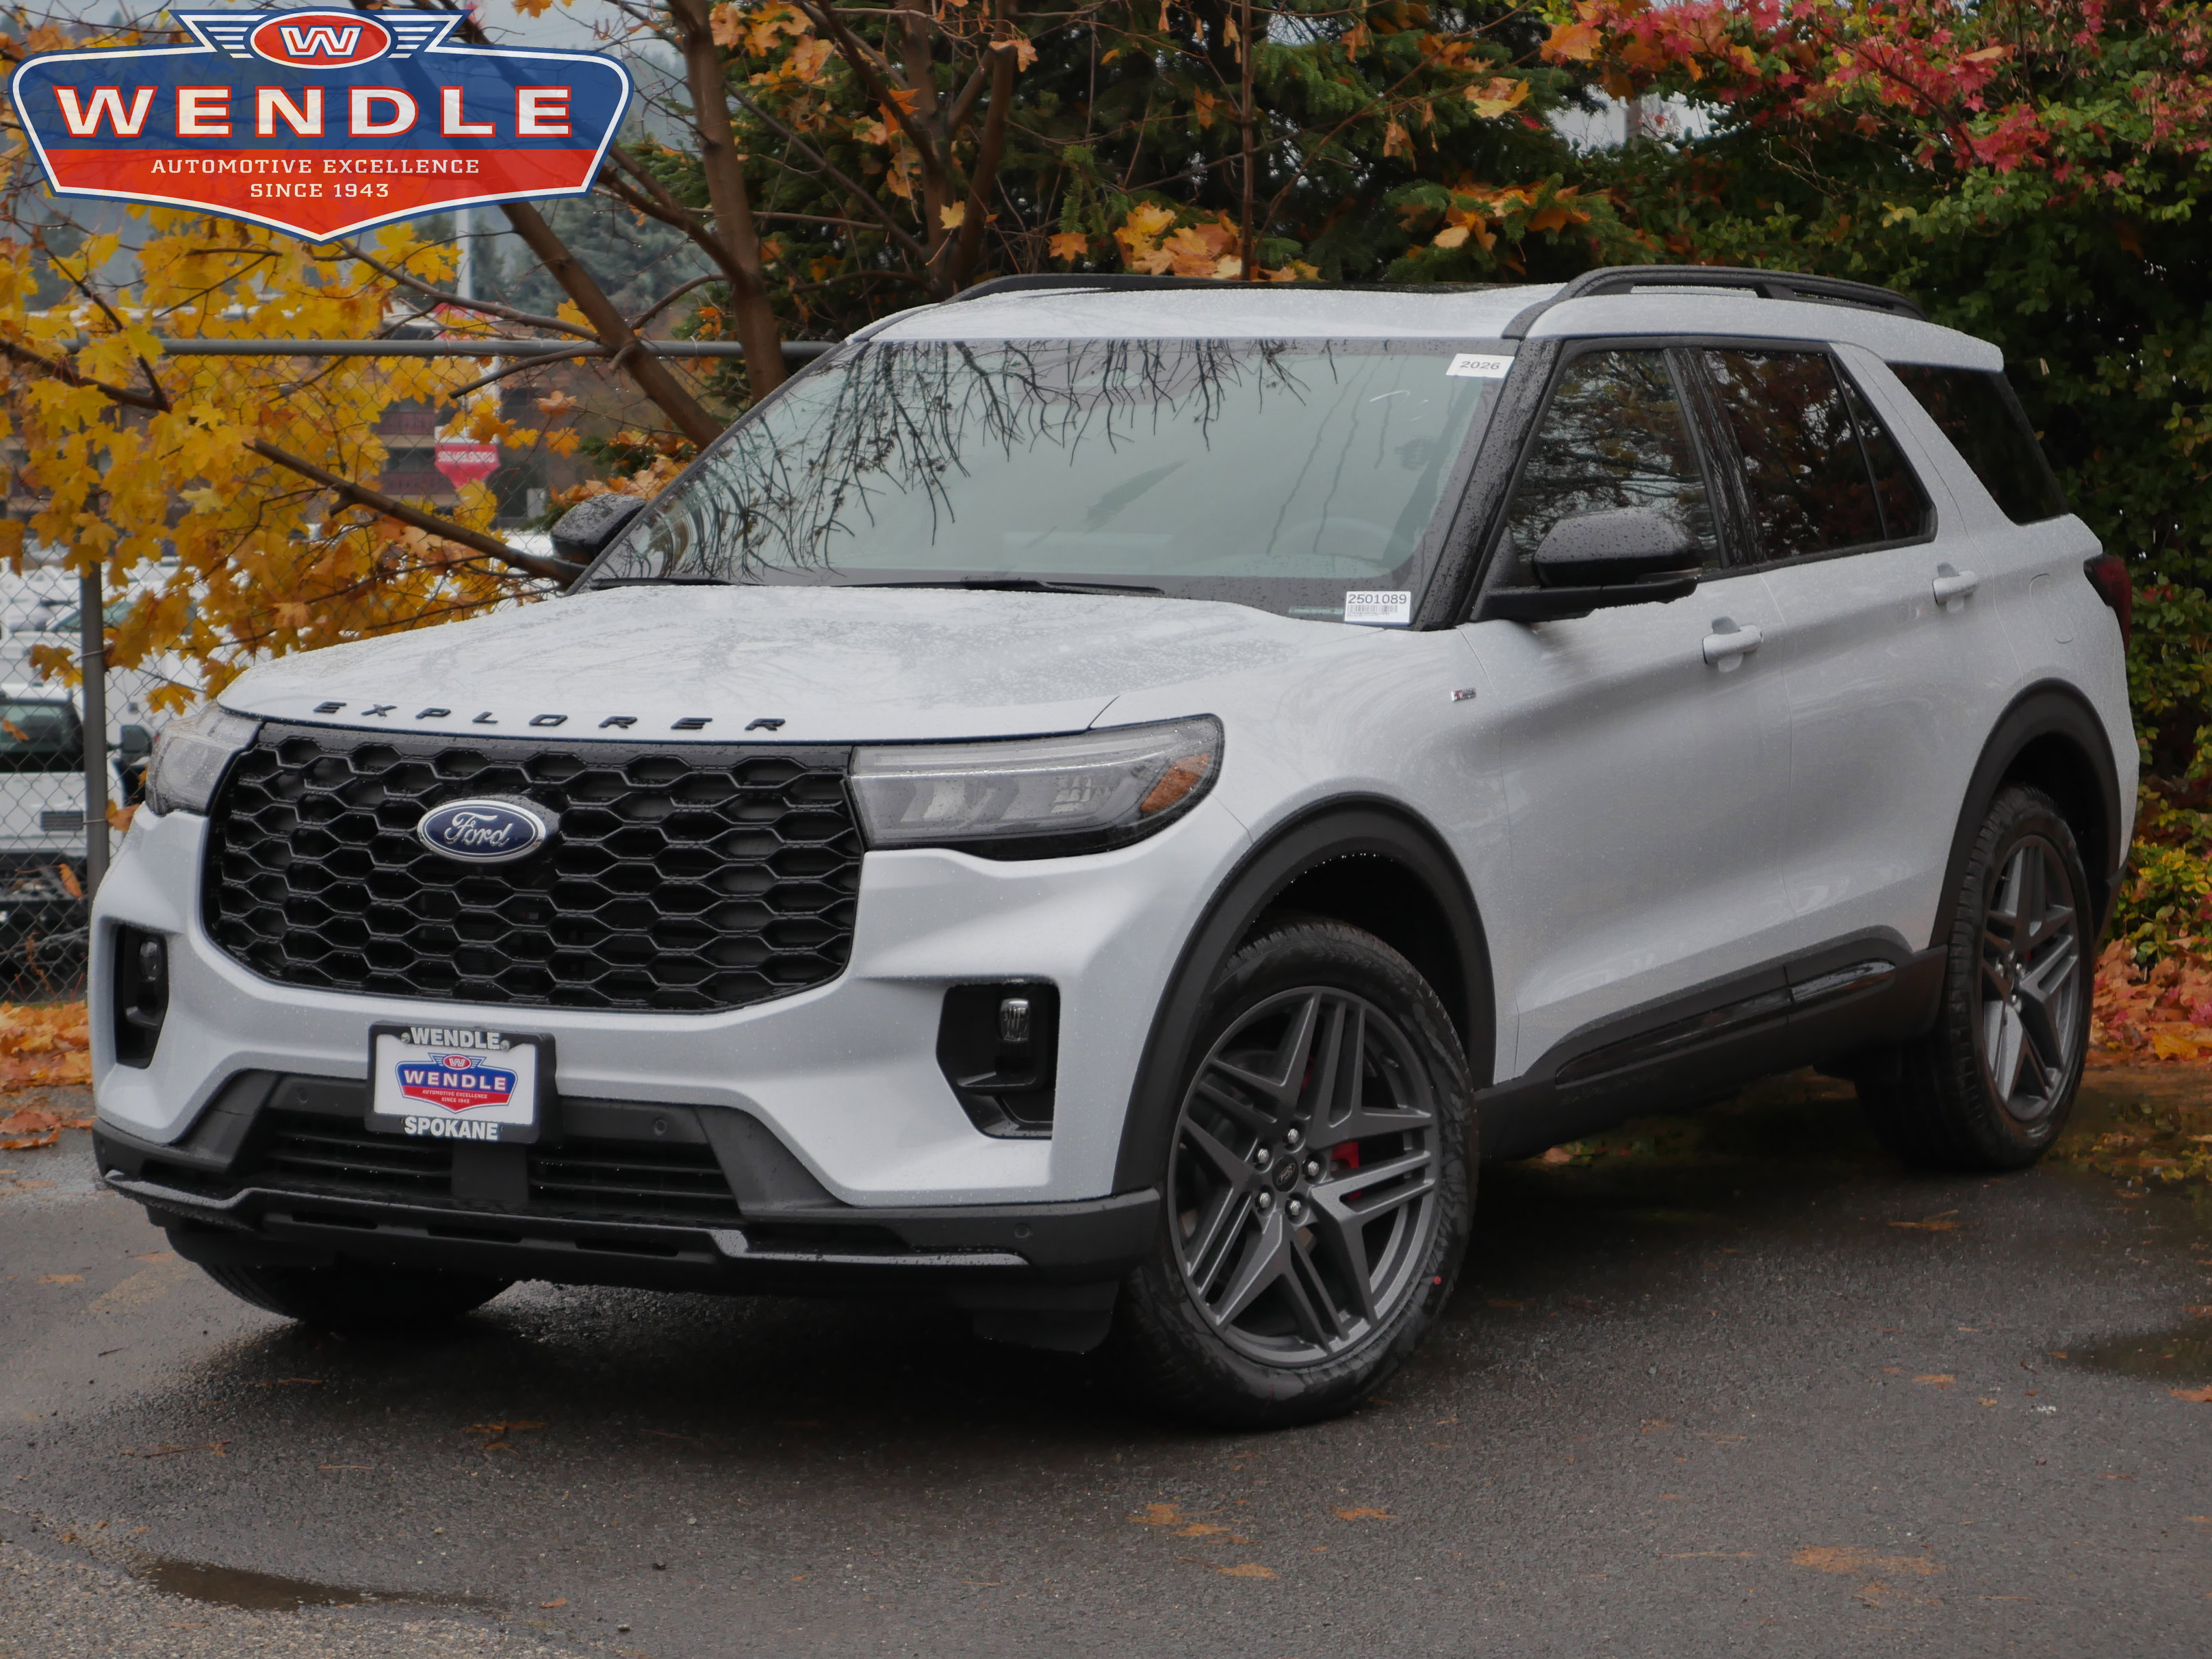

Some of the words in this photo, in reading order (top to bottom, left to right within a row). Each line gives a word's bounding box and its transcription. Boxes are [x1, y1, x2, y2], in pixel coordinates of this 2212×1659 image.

[1459, 361, 1501, 370] 2026
[1348, 594, 1407, 604] 2501089
[313, 701, 786, 732] EXPLORER
[445, 812, 513, 847] Ford
[411, 1027, 500, 1050] WENDLE
[404, 1070, 506, 1090] WENDLE
[404, 1116, 498, 1140] SPOKANE
